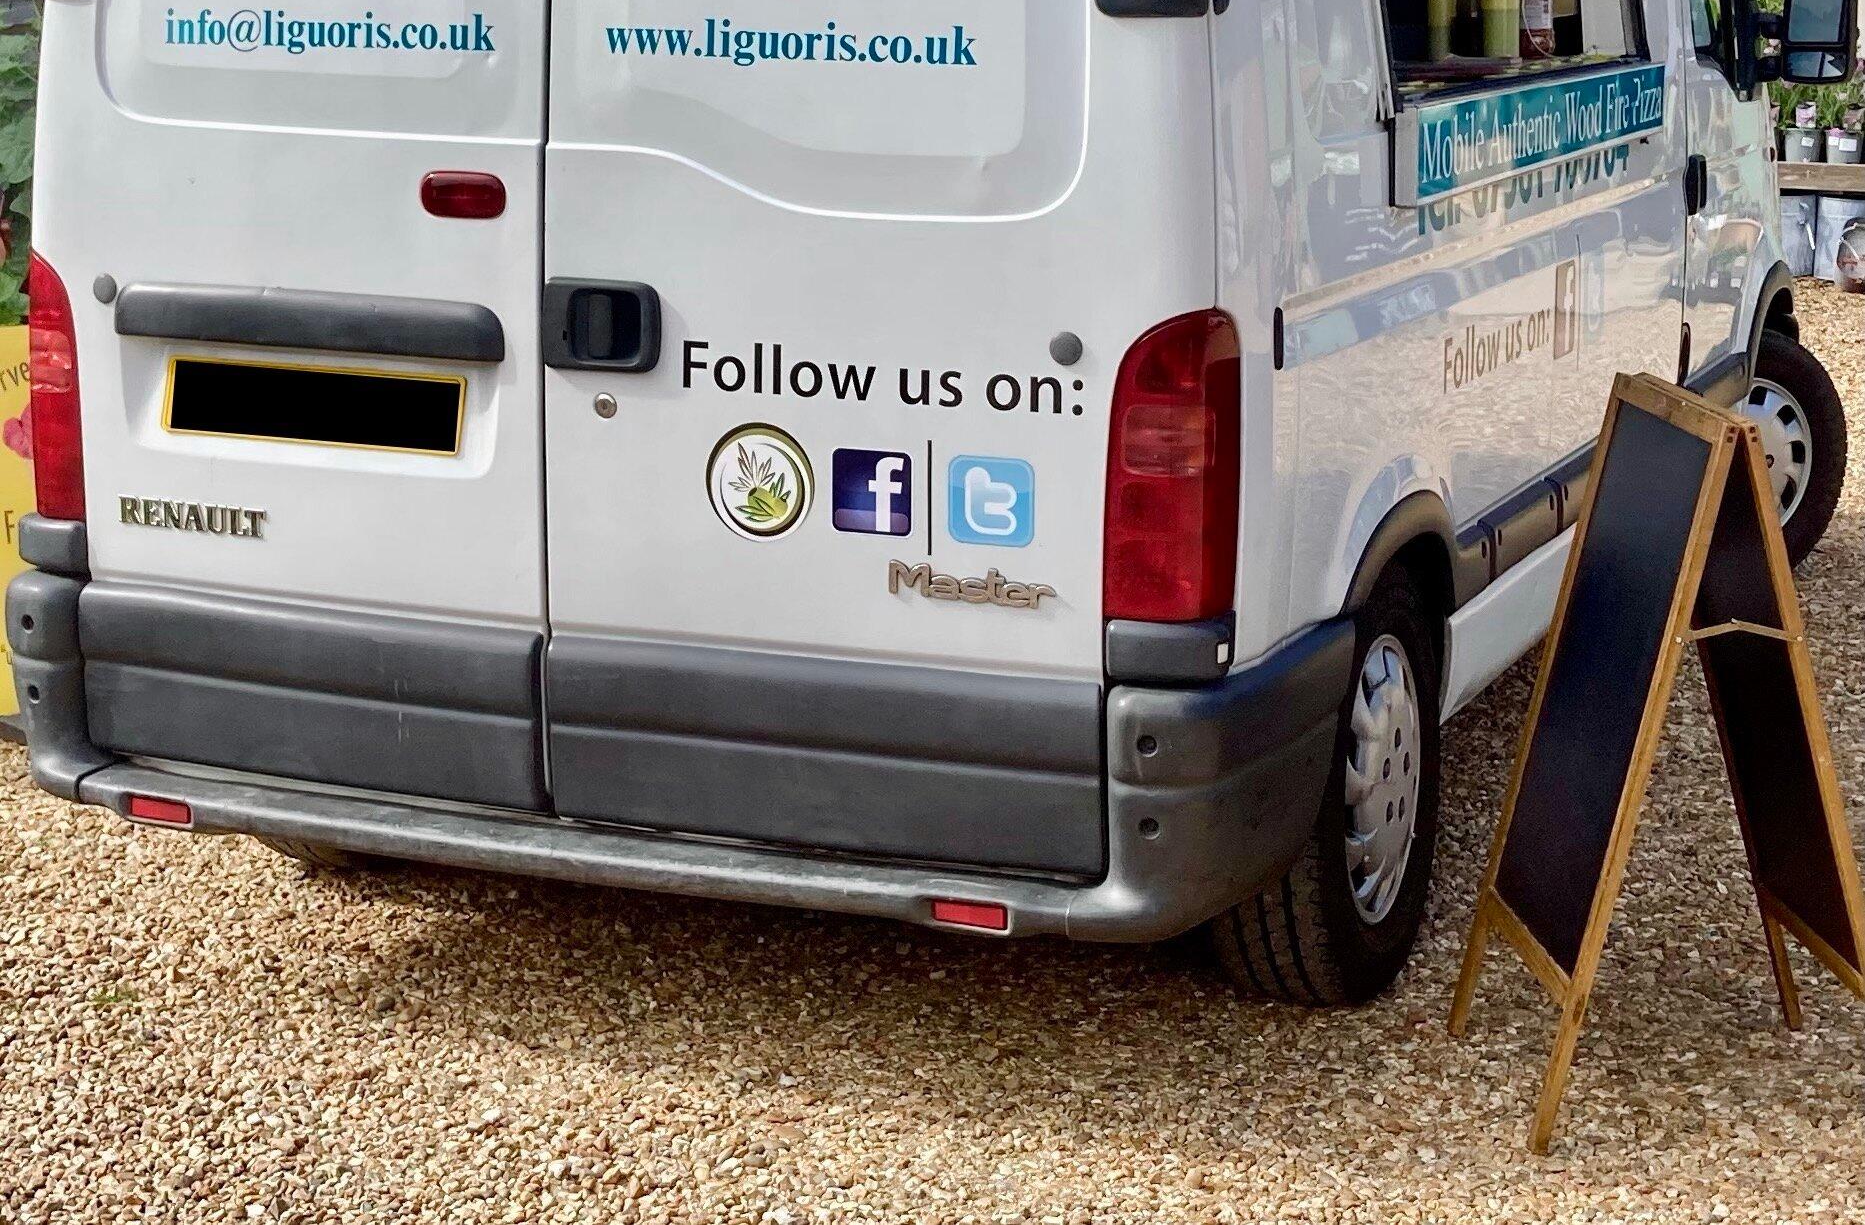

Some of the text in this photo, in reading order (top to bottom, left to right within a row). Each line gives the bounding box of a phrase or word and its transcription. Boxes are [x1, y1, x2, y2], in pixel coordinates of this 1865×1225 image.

[165, 9, 496, 55] info@liguoris.co.uk
[605, 18, 978, 67] www.liguoris.co.uk
[1421, 110, 1485, 183] Mobile
[1488, 95, 1561, 167] Authentic
[1564, 84, 1603, 144] Wood
[1605, 81, 1631, 134] Fire
[1631, 75, 1663, 126] Pizza
[1443, 307, 1551, 395] Follow us on:
[682, 339, 1085, 417] Follow us on:
[117, 493, 267, 540] RENAULT
[887, 558, 1057, 610] Master
